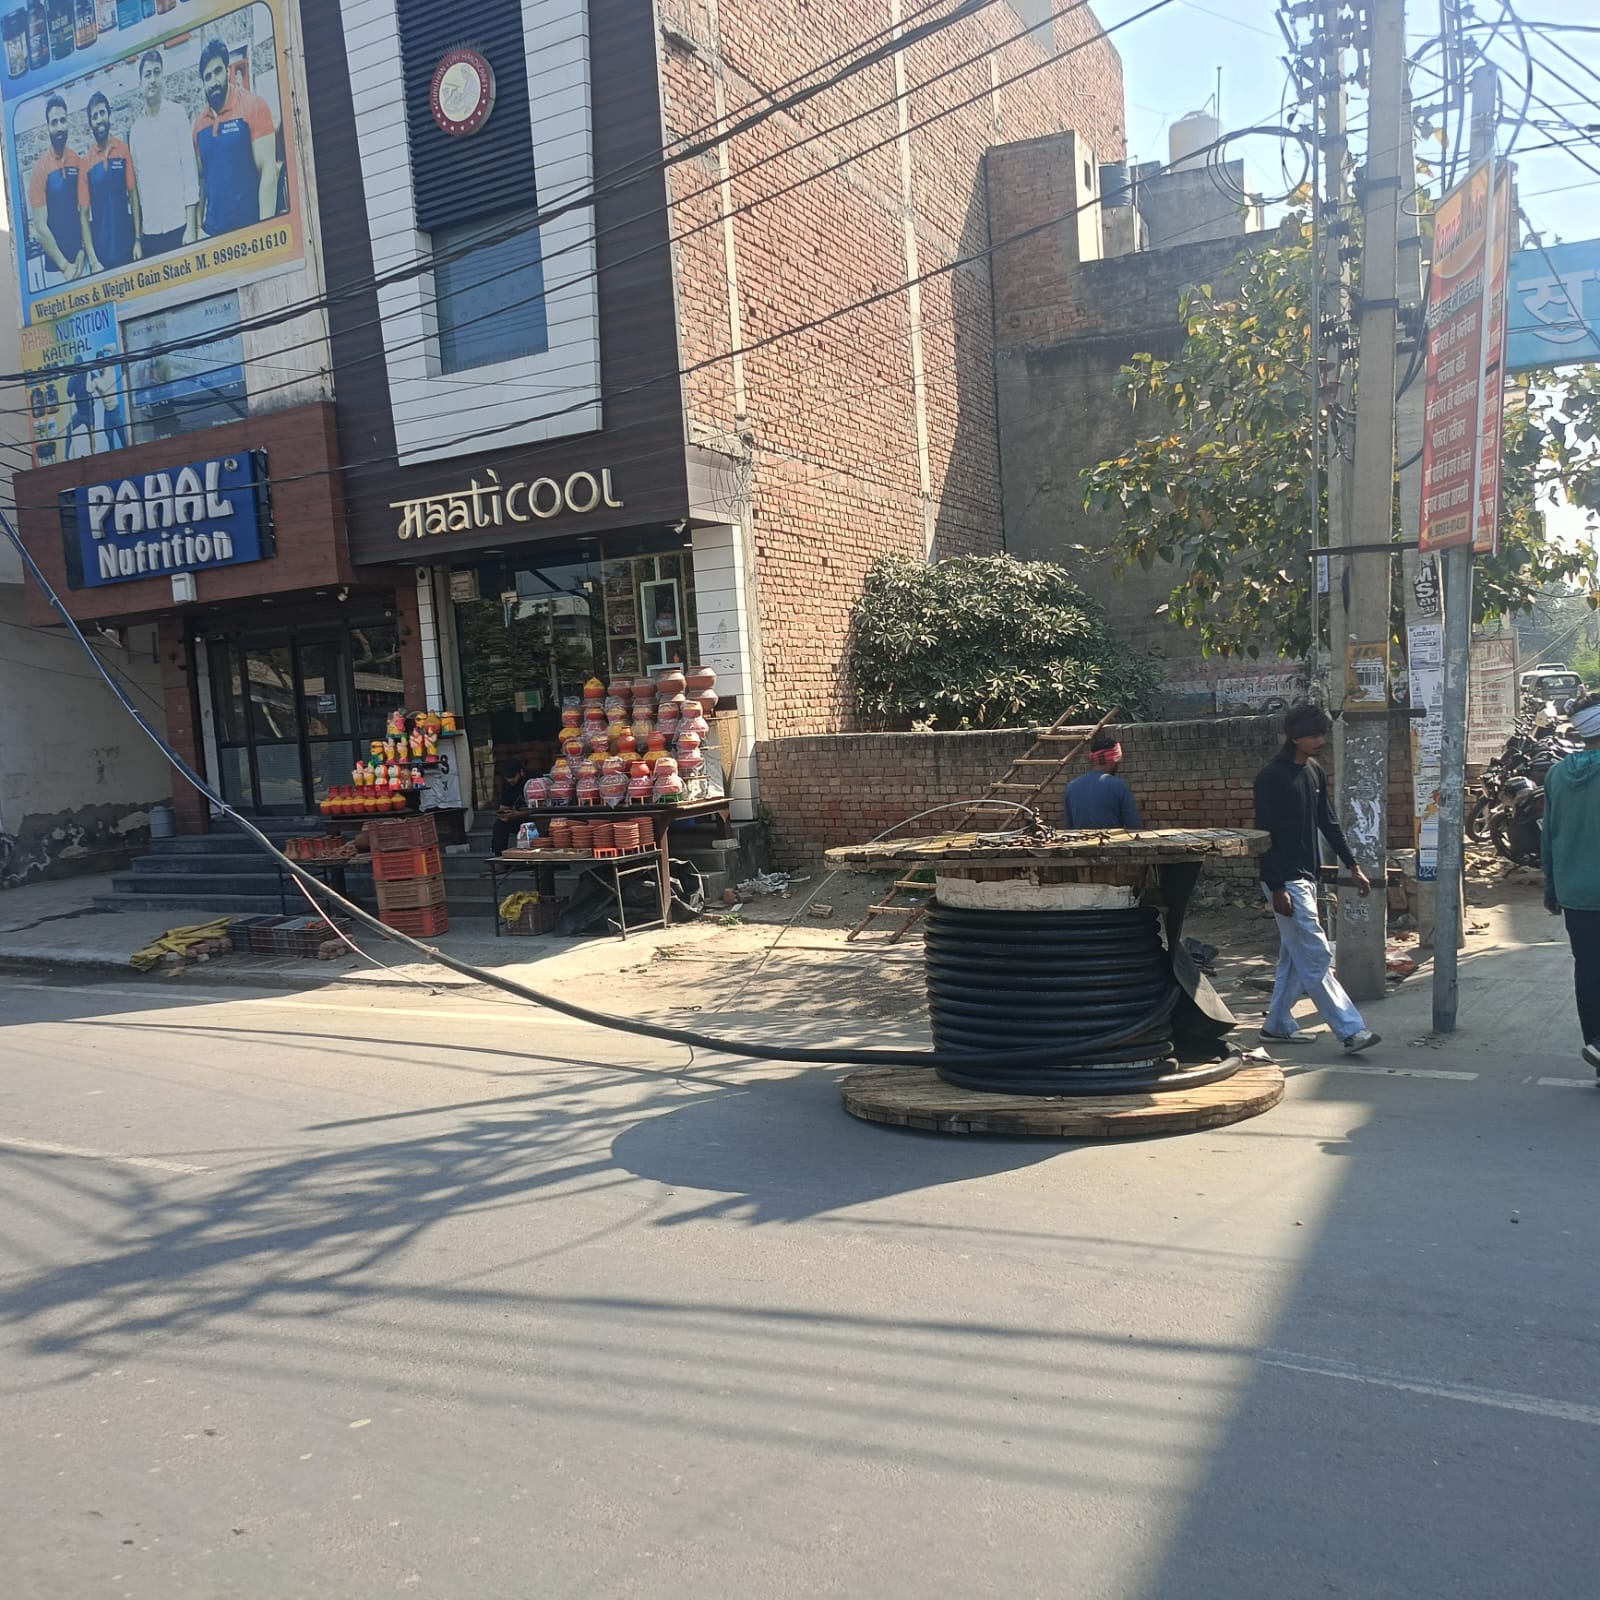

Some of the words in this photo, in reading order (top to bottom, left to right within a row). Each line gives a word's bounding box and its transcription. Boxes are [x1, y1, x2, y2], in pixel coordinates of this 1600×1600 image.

[35, 298, 66, 319] Weight
[68, 293, 89, 310] Loss
[92, 287, 100, 301] &
[102, 276, 134, 298] Weight
[137, 269, 161, 288] Gain
[162, 259, 192, 281] Stack
[195, 253, 210, 271] M.
[213, 229, 287, 266] 98962-61610
[42, 337, 93, 363] KAITHAL
[55, 307, 110, 342] NUTRITION
[88, 462, 234, 540] PAHAL
[98, 527, 233, 579] Nutrition
